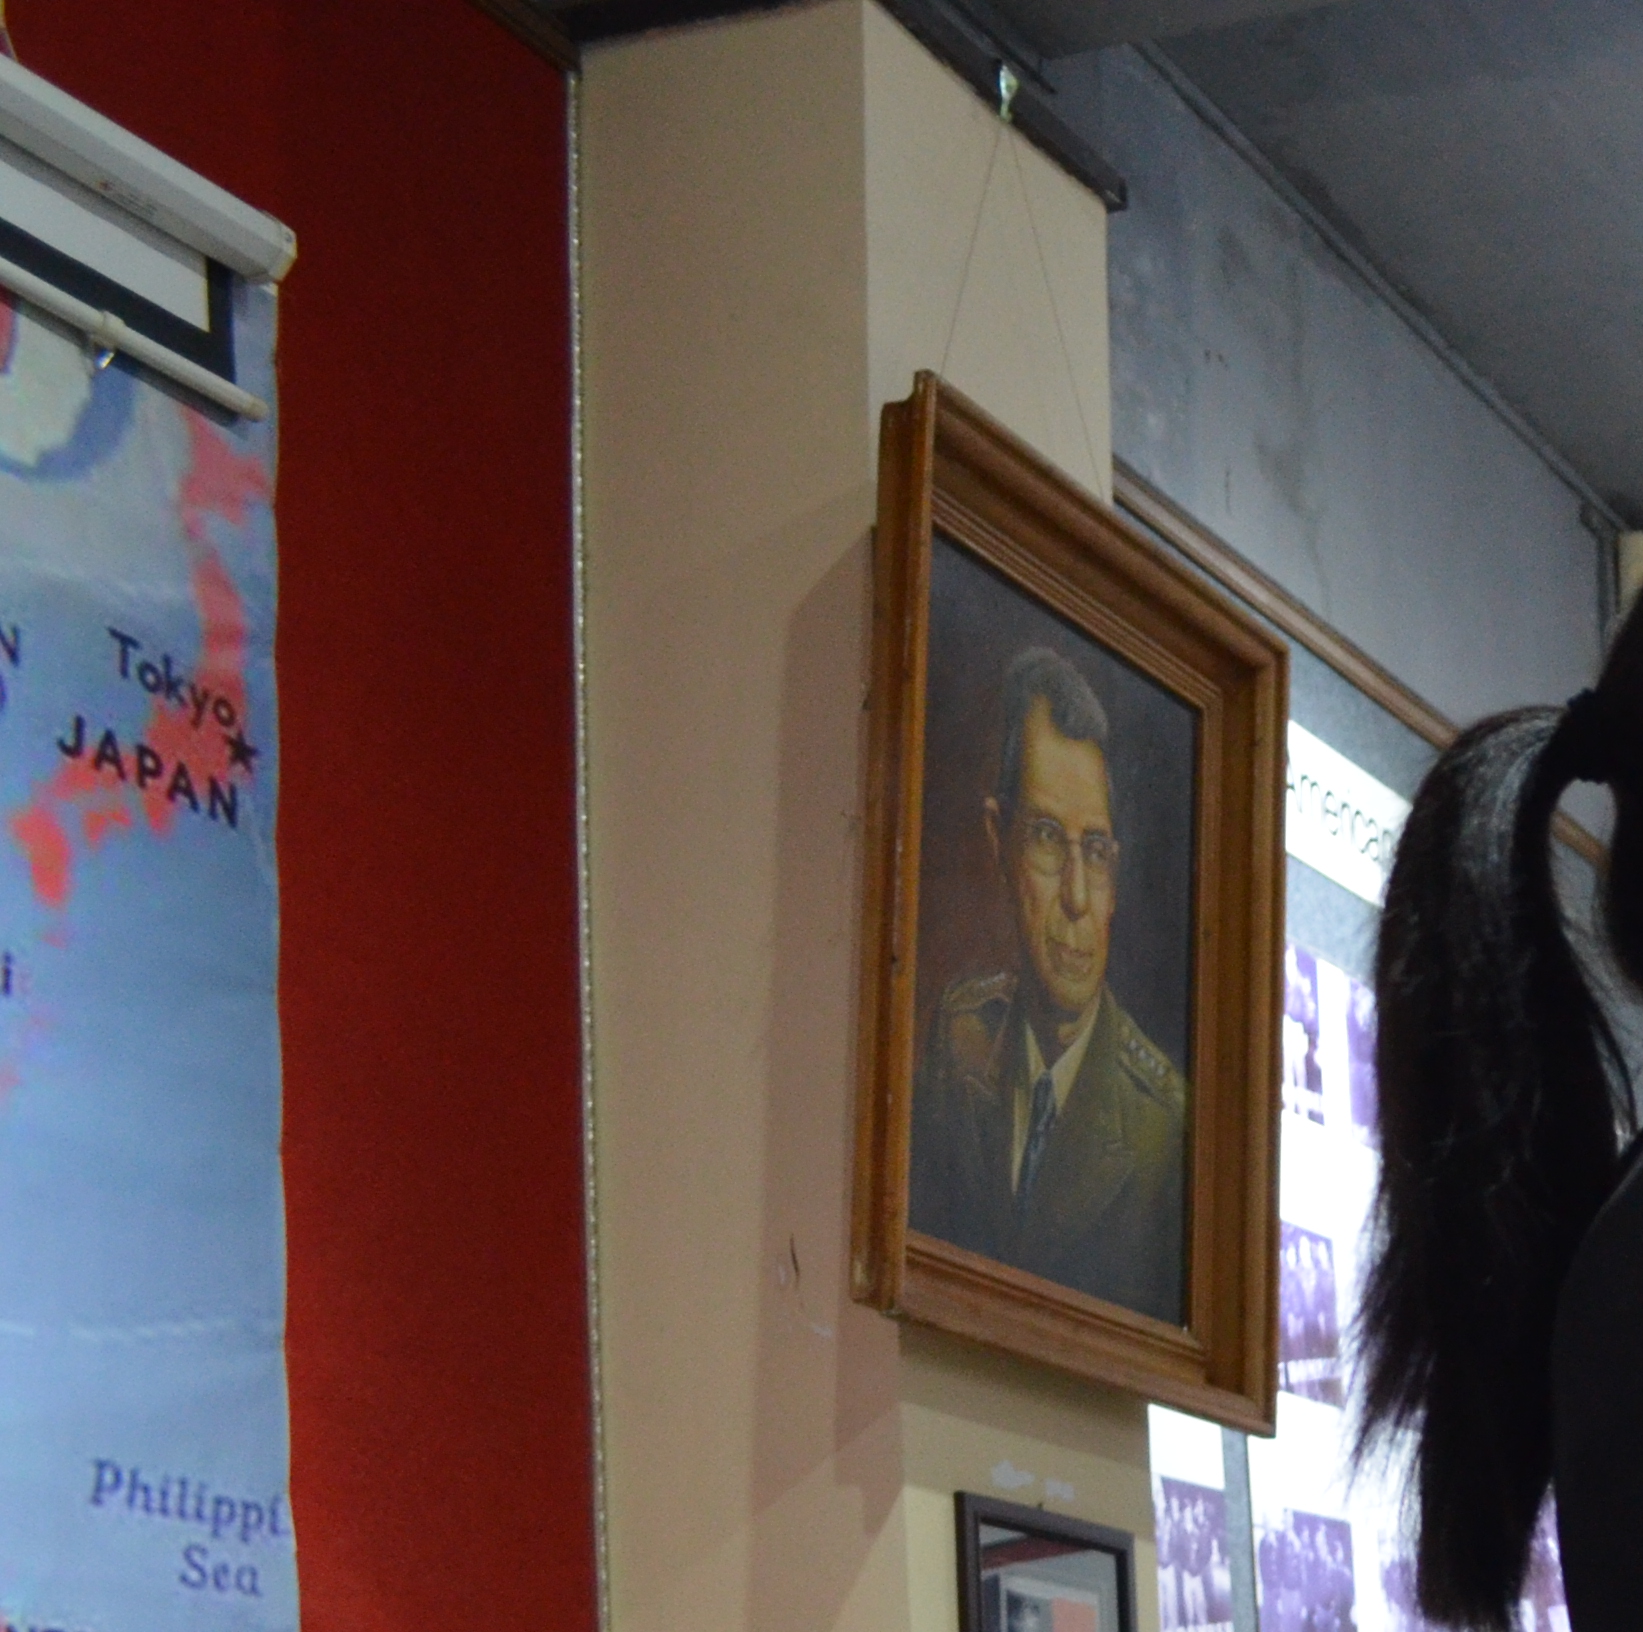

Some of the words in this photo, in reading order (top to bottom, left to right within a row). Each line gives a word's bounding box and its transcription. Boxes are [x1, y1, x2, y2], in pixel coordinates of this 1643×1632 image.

[107, 625, 236, 730] Tokyo
[56, 714, 240, 830] JAPAN
[178, 1543, 263, 1598] Sea
